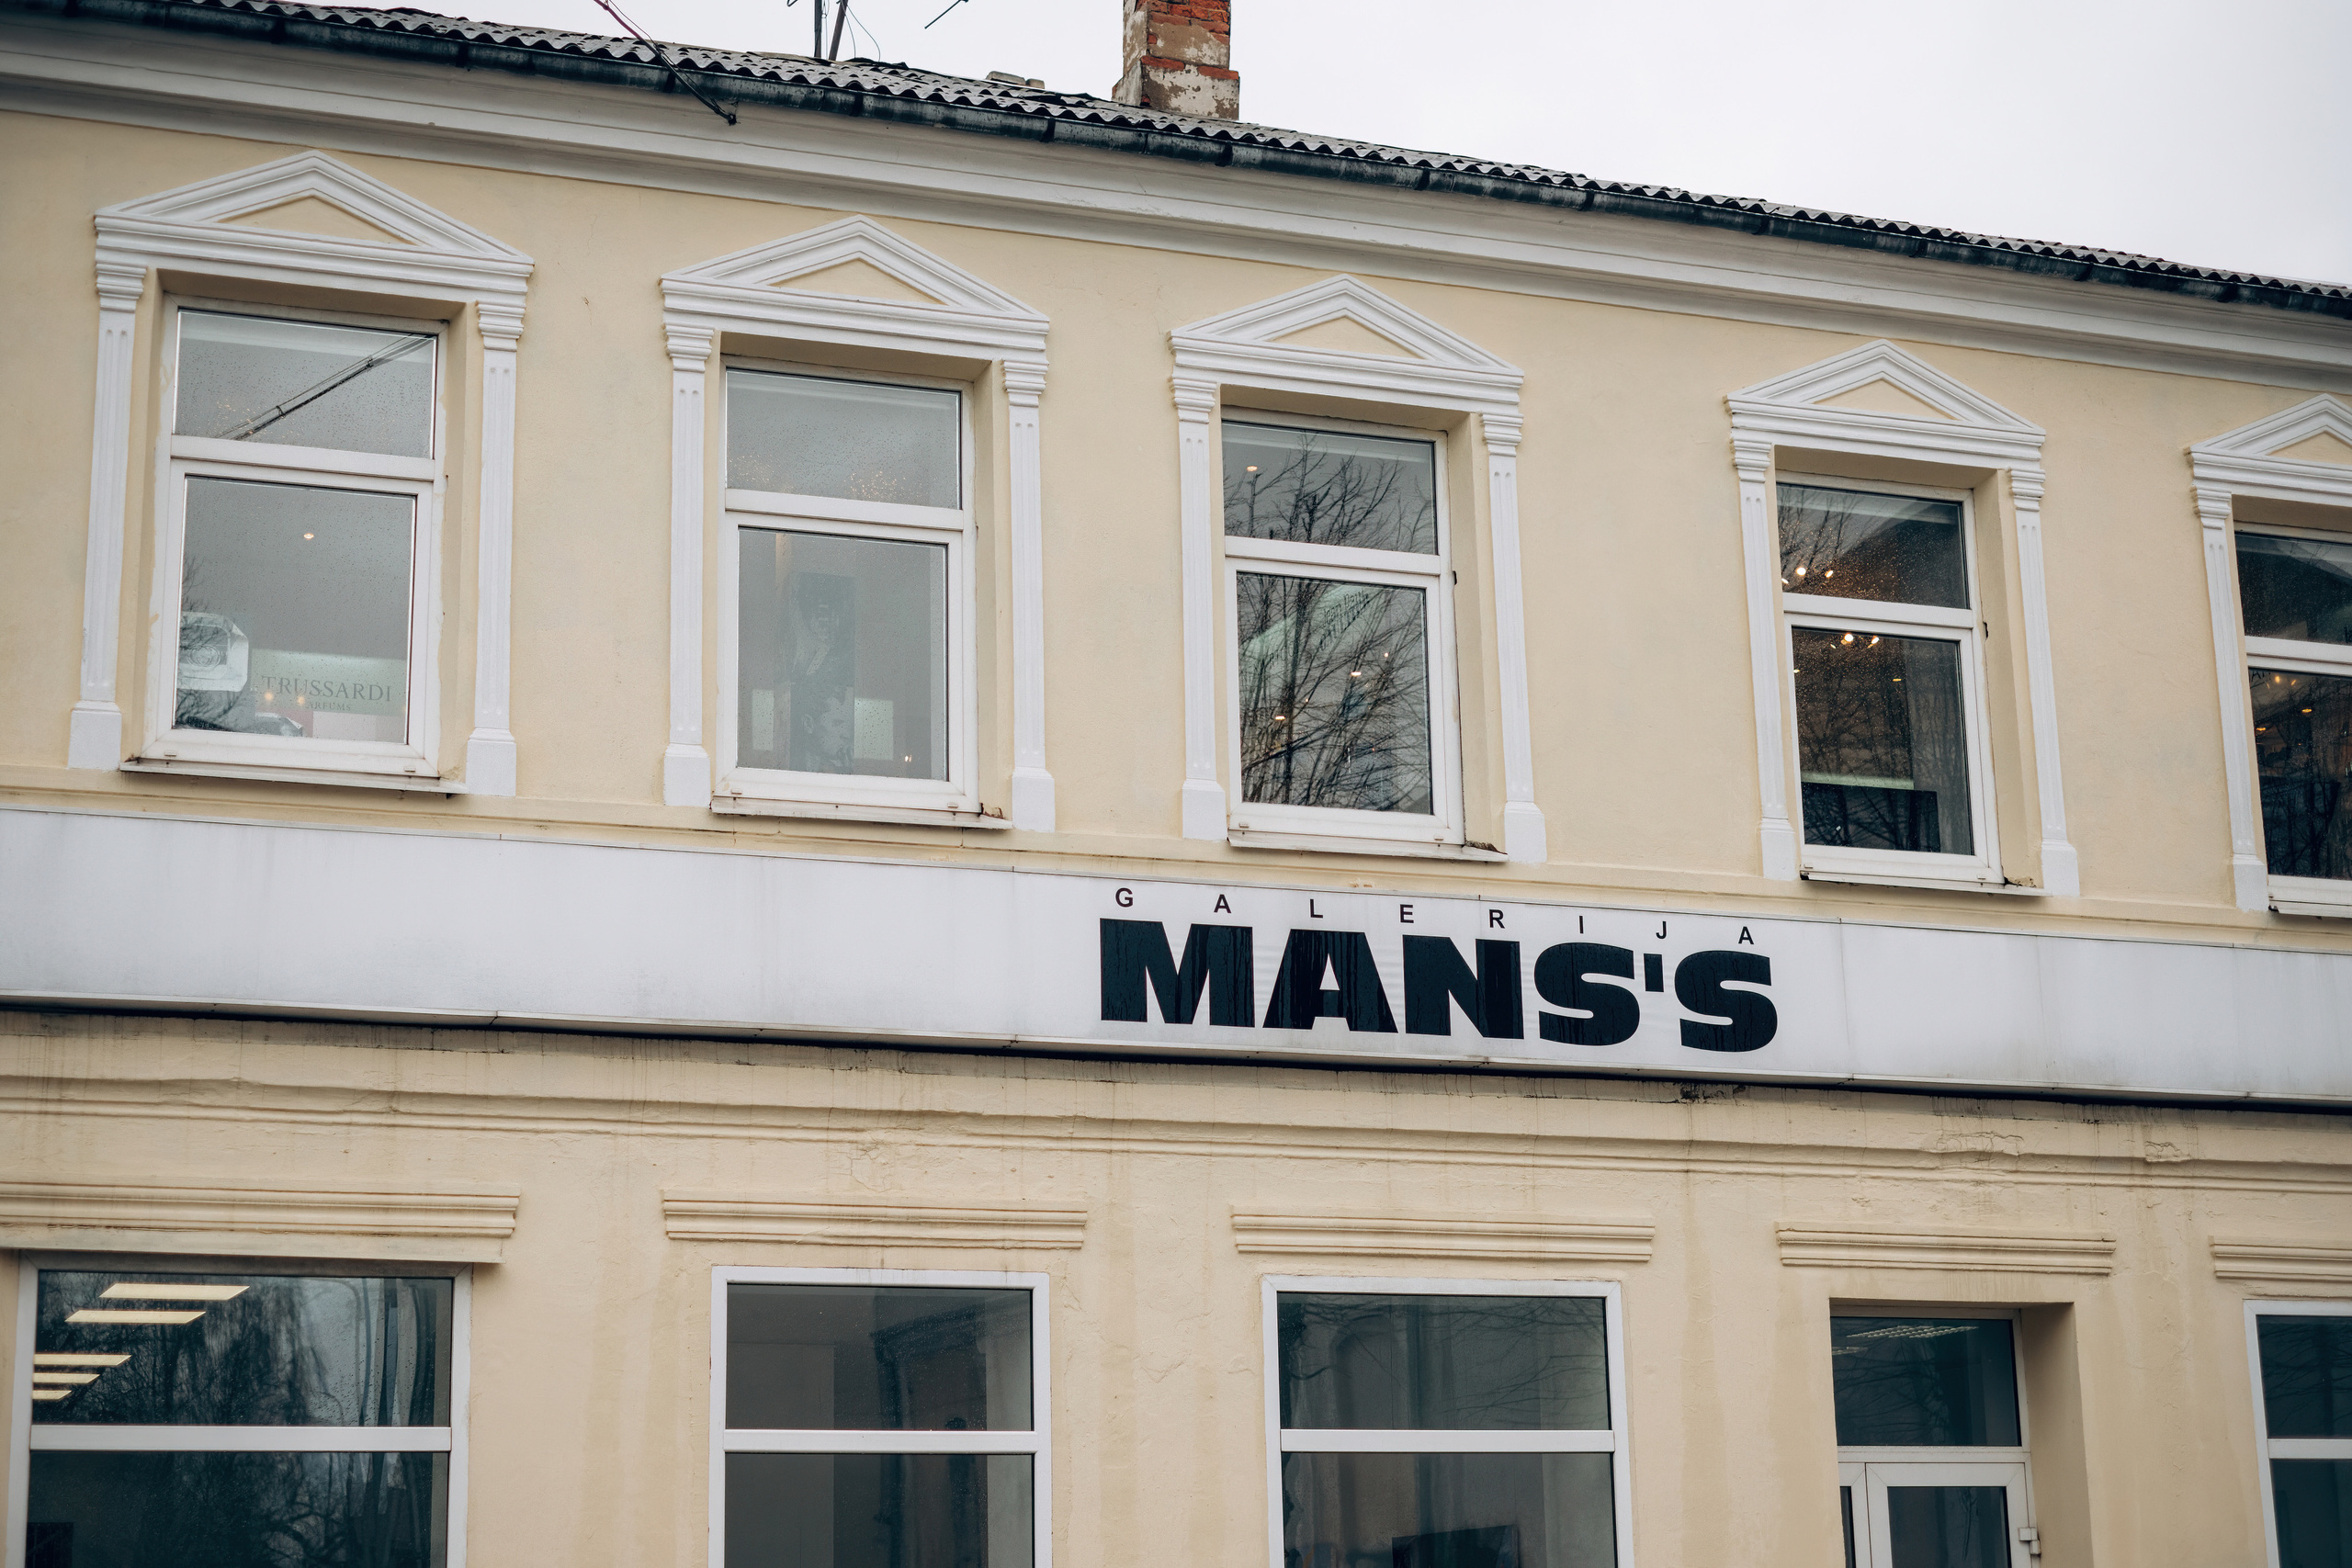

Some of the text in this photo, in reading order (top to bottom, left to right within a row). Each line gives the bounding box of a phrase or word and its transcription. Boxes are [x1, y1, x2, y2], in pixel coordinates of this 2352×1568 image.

[261, 675, 391, 702] TRUSSARDI
[300, 699, 352, 712] ARFUMS
[1114, 886, 1756, 946] GALERIJA
[1099, 917, 1779, 1053] MANS'S
